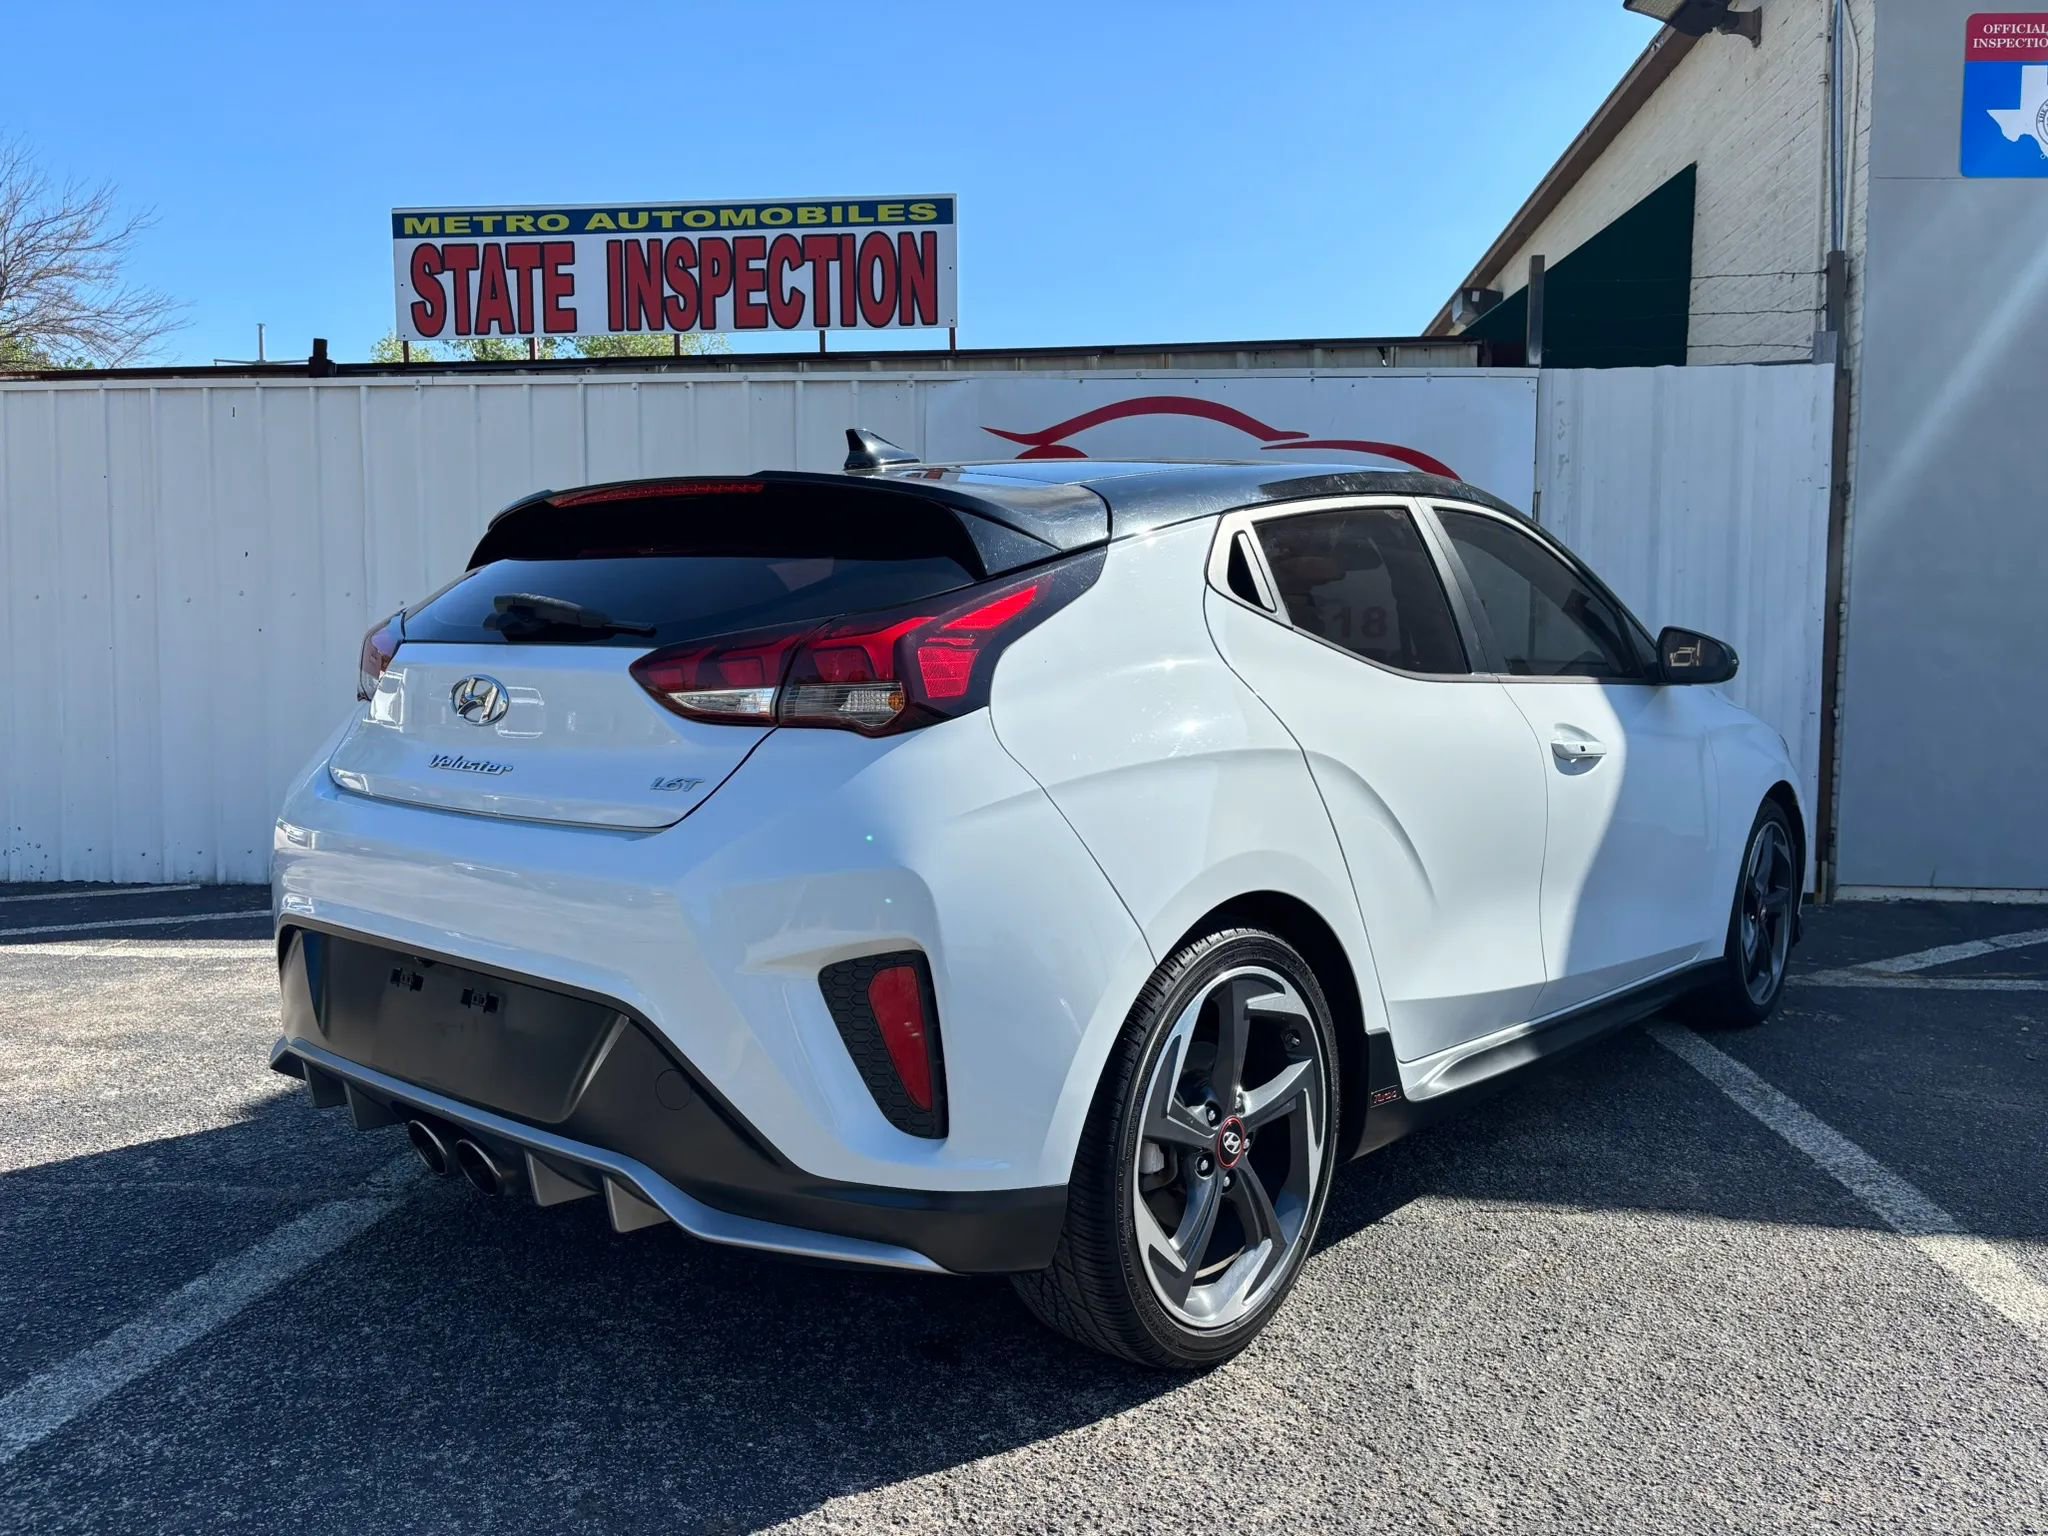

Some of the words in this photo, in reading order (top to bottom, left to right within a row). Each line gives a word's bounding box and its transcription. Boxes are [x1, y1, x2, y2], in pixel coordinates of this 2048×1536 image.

[1983, 24, 2048, 34] OFFICIAL
[402, 213, 571, 235] METRO
[584, 203, 938, 231] AUTOMOBILES
[410, 240, 578, 338] STATE
[606, 230, 938, 332] INSPECTION
